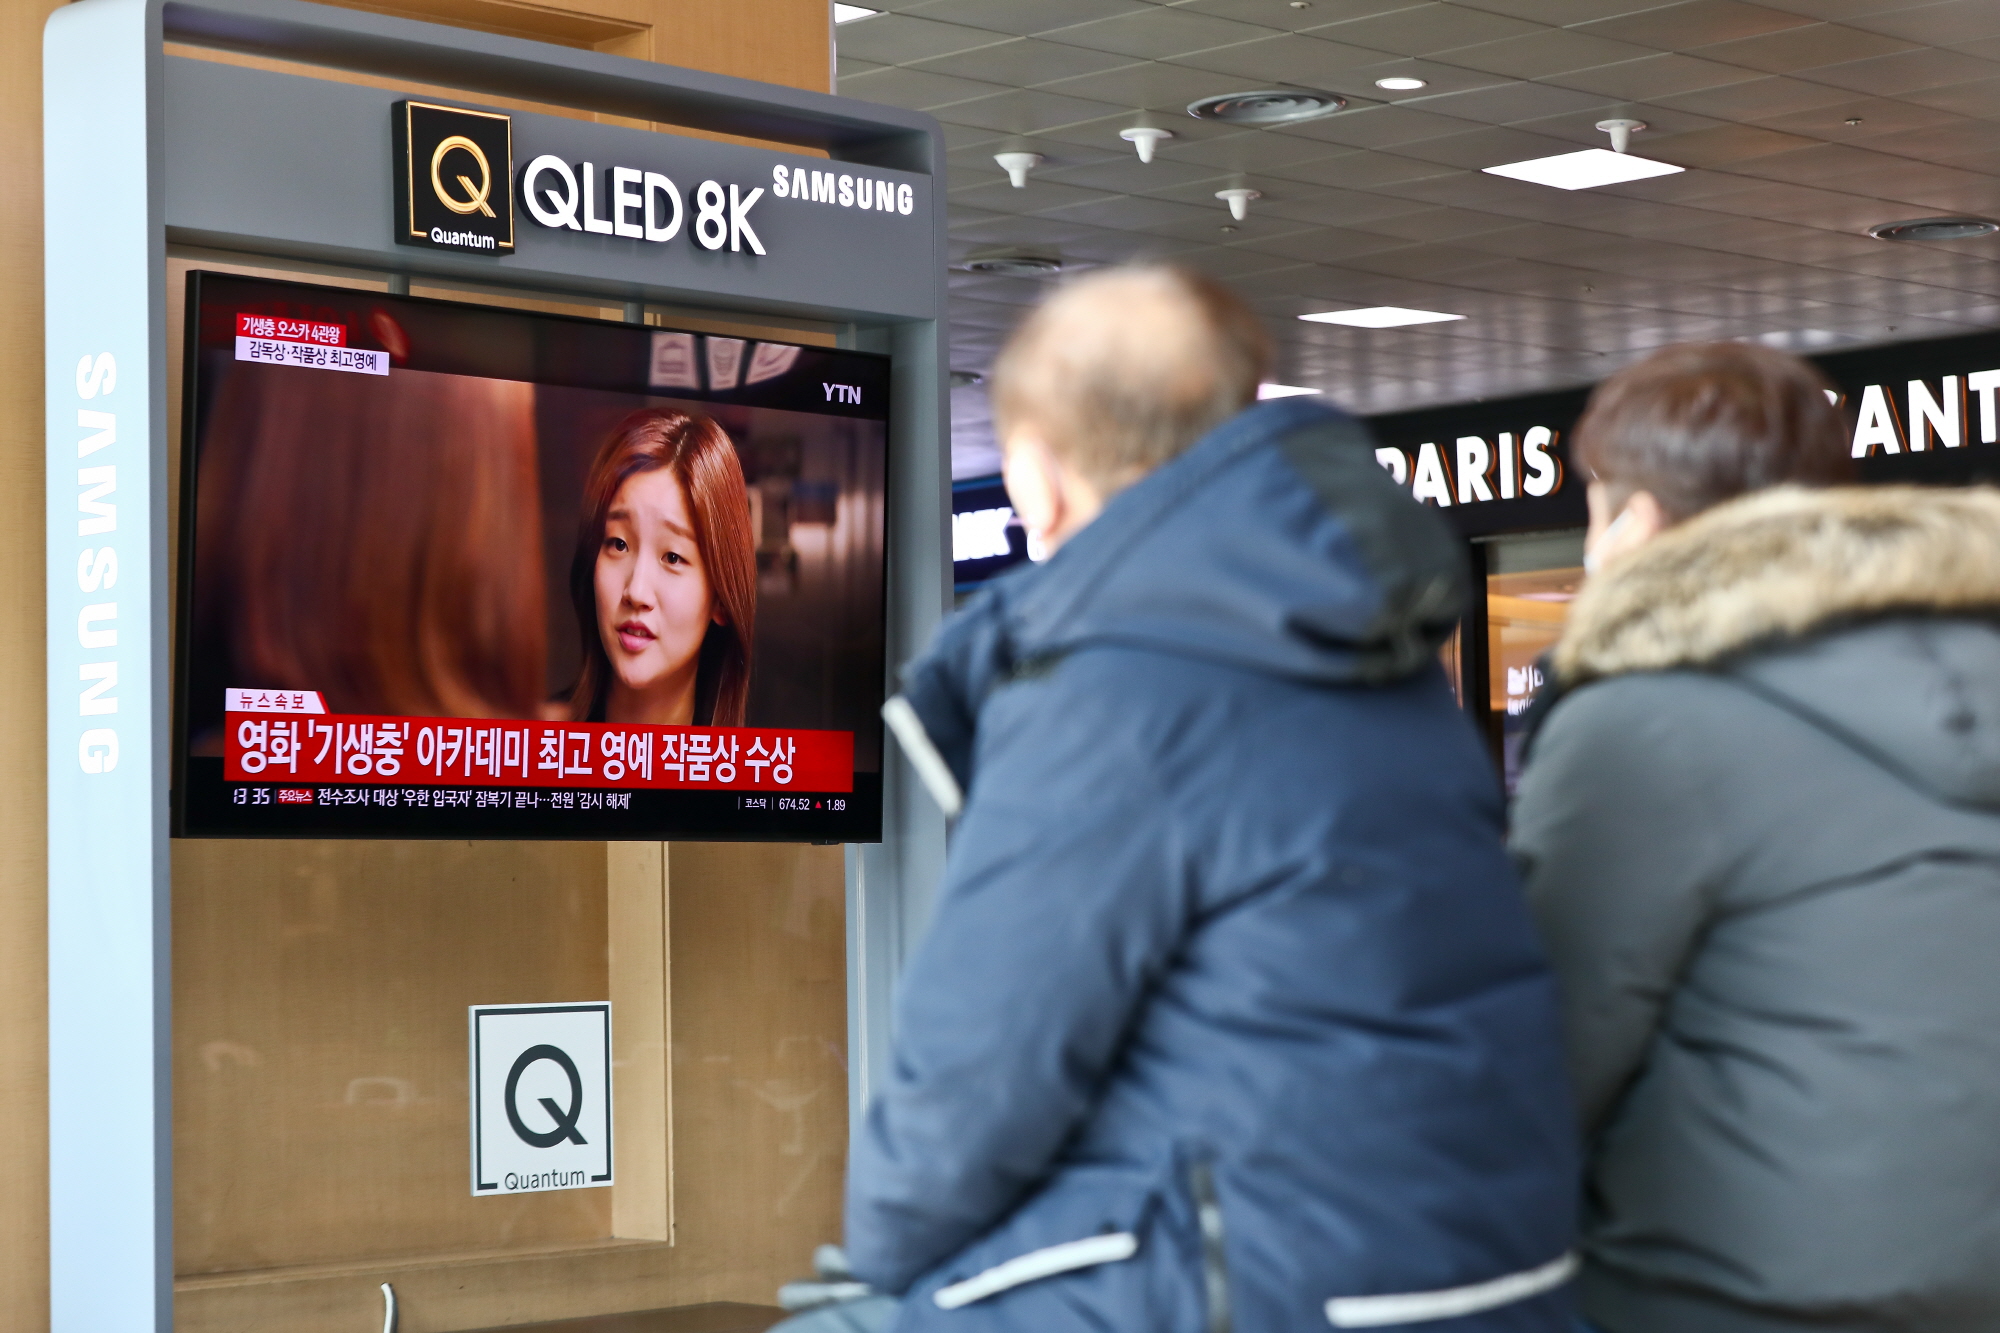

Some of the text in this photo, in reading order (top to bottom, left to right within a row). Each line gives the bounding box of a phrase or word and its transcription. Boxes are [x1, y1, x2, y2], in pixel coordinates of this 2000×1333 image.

[430, 135, 496, 218] Q
[773, 164, 914, 216] SAMSUNG
[523, 155, 766, 255] QLED 8K
[430, 226, 495, 250] Quantum
[242, 317, 276, 337] 기생충
[276, 321, 310, 341] 오스카
[311, 324, 340, 345] 4관왕
[822, 382, 862, 405] YTN
[1823, 369, 2000, 459] ANT
[75, 351, 119, 774] SAMSUNG
[240, 692, 305, 710] 뉴스속보
[237, 719, 796, 784] 영화 '기생충' 아카데미 최고 영예 작품상 수상
[279, 789, 313, 803] 주요뉴스
[317, 788, 370, 806] 전수조사
[373, 789, 399, 807] 대상
[475, 791, 512, 808] 잠복기
[745, 798, 846, 811] 코스닥 674.52 1.89
[504, 1044, 588, 1148] Q
[504, 1168, 585, 1190] Quantum
